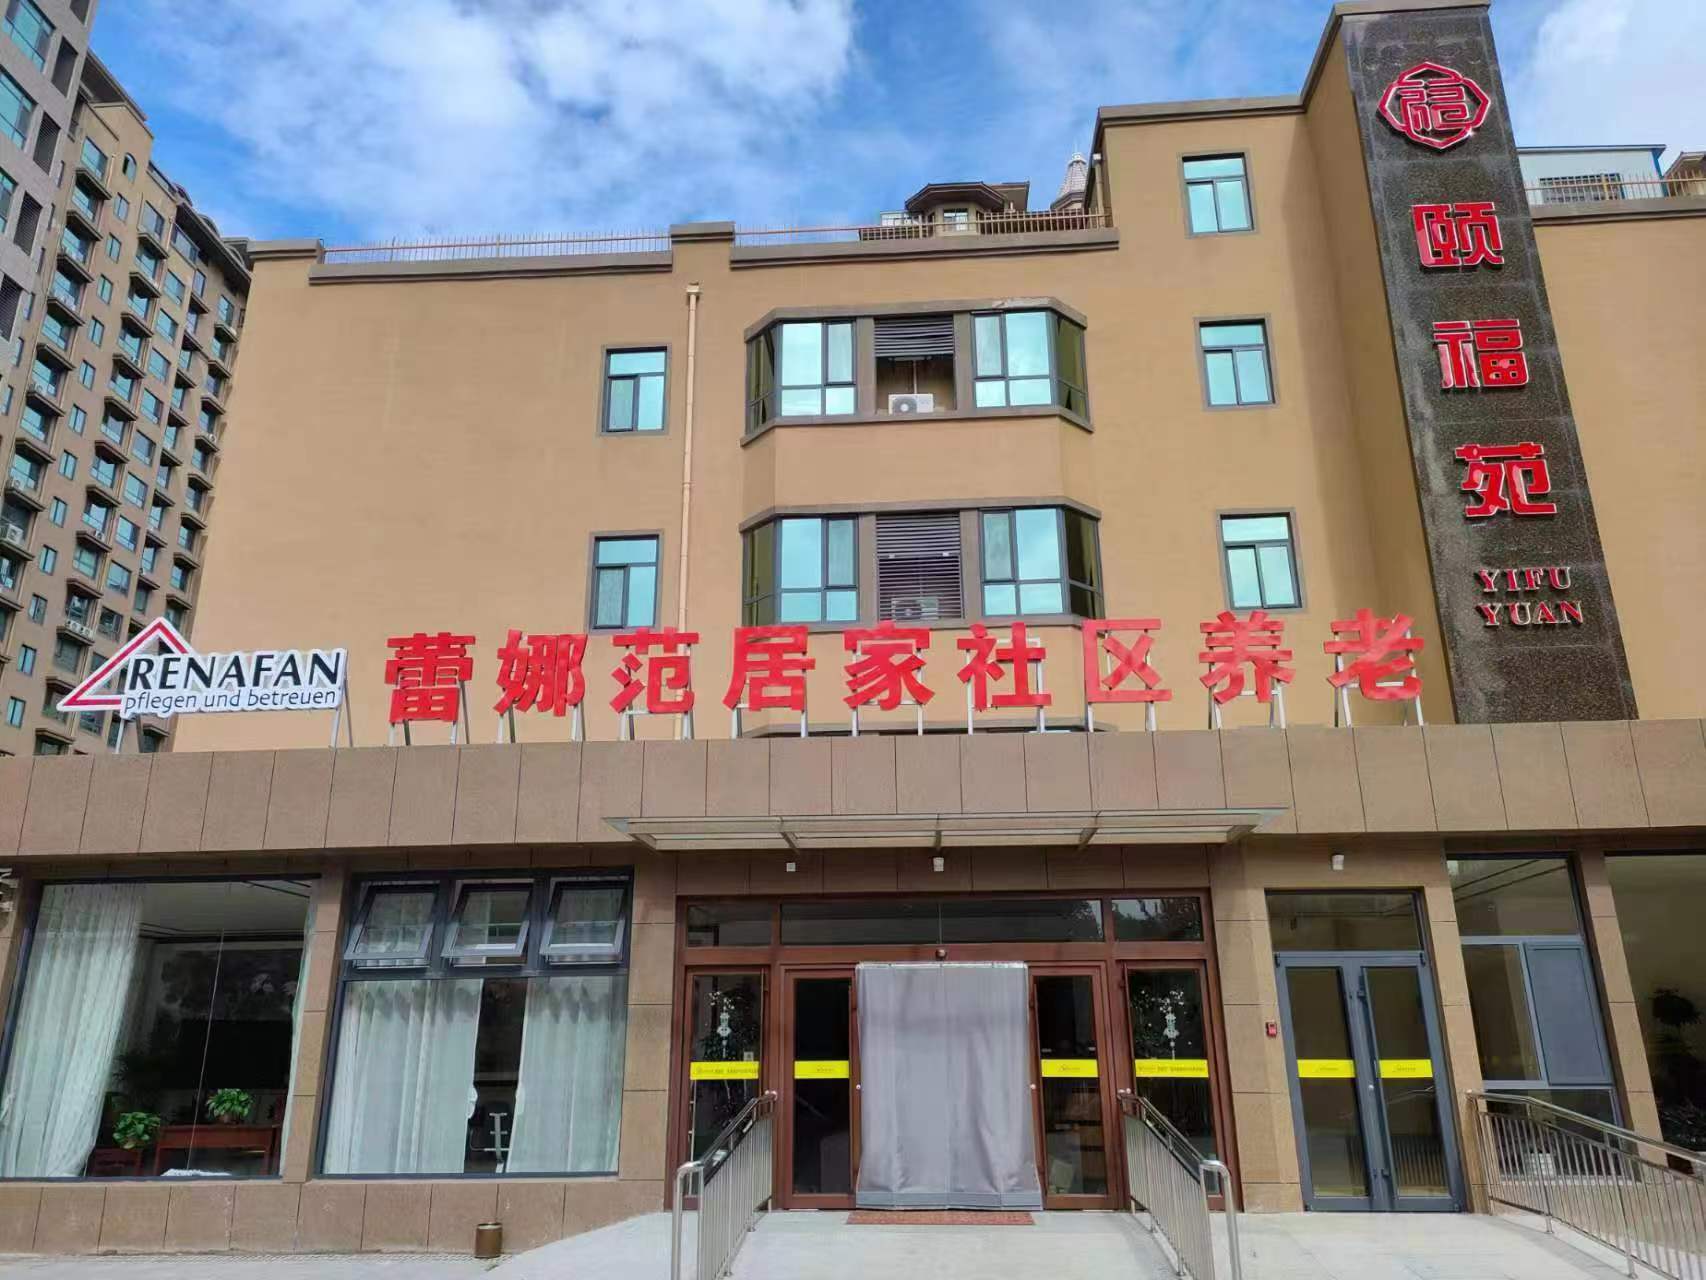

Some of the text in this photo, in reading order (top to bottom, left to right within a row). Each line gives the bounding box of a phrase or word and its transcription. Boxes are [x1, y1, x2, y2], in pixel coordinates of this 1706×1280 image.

[1411, 201, 1558, 516] 颐福苑
[1477, 566, 1572, 592] YIFU
[1477, 601, 1584, 626] YUAN
[129, 652, 341, 690] RENAFAN
[385, 608, 1425, 723] 蕾娜范居家社区养老
[124, 688, 336, 714] pflegen und betreuen
